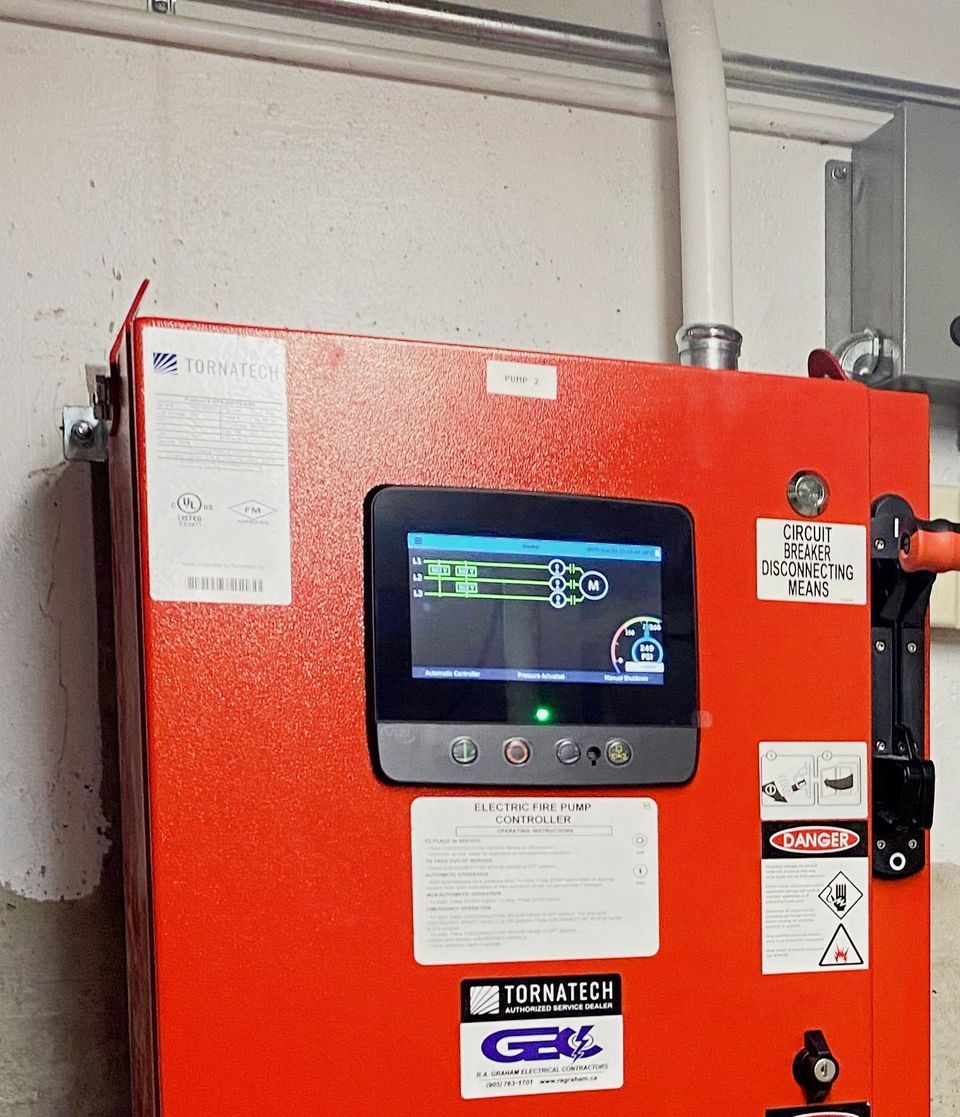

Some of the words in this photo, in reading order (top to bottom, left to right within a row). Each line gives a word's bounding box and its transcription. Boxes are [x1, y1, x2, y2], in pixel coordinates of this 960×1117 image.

[186, 358, 279, 380] TORNATECH
[504, 375, 528, 384] PUMP
[178, 514, 202, 522] LISTED
[783, 524, 832, 542] CIRCUIT
[784, 543, 831, 561] BREAKER
[762, 560, 854, 580] DISCONNECTING
[588, 580, 600, 591] M
[788, 580, 829, 598] MEANS
[624, 674, 648, 682] Shutdown
[474, 803, 529, 812] ELECTRIC
[533, 803, 558, 812] FIRE
[560, 803, 591, 812] PUMP
[496, 815, 571, 824] CONTROLLER
[783, 832, 849, 848] DANGER
[504, 981, 613, 1004] TORNATECH
[505, 1004, 552, 1014] AUTHORIZED
[553, 1003, 584, 1012] SERVICE
[585, 1002, 613, 1010] DEALER
[491, 1069, 519, 1077] GRAHAM
[520, 1066, 559, 1075] ELECTRICAL
[562, 1064, 608, 1072] CONTRACTORS
